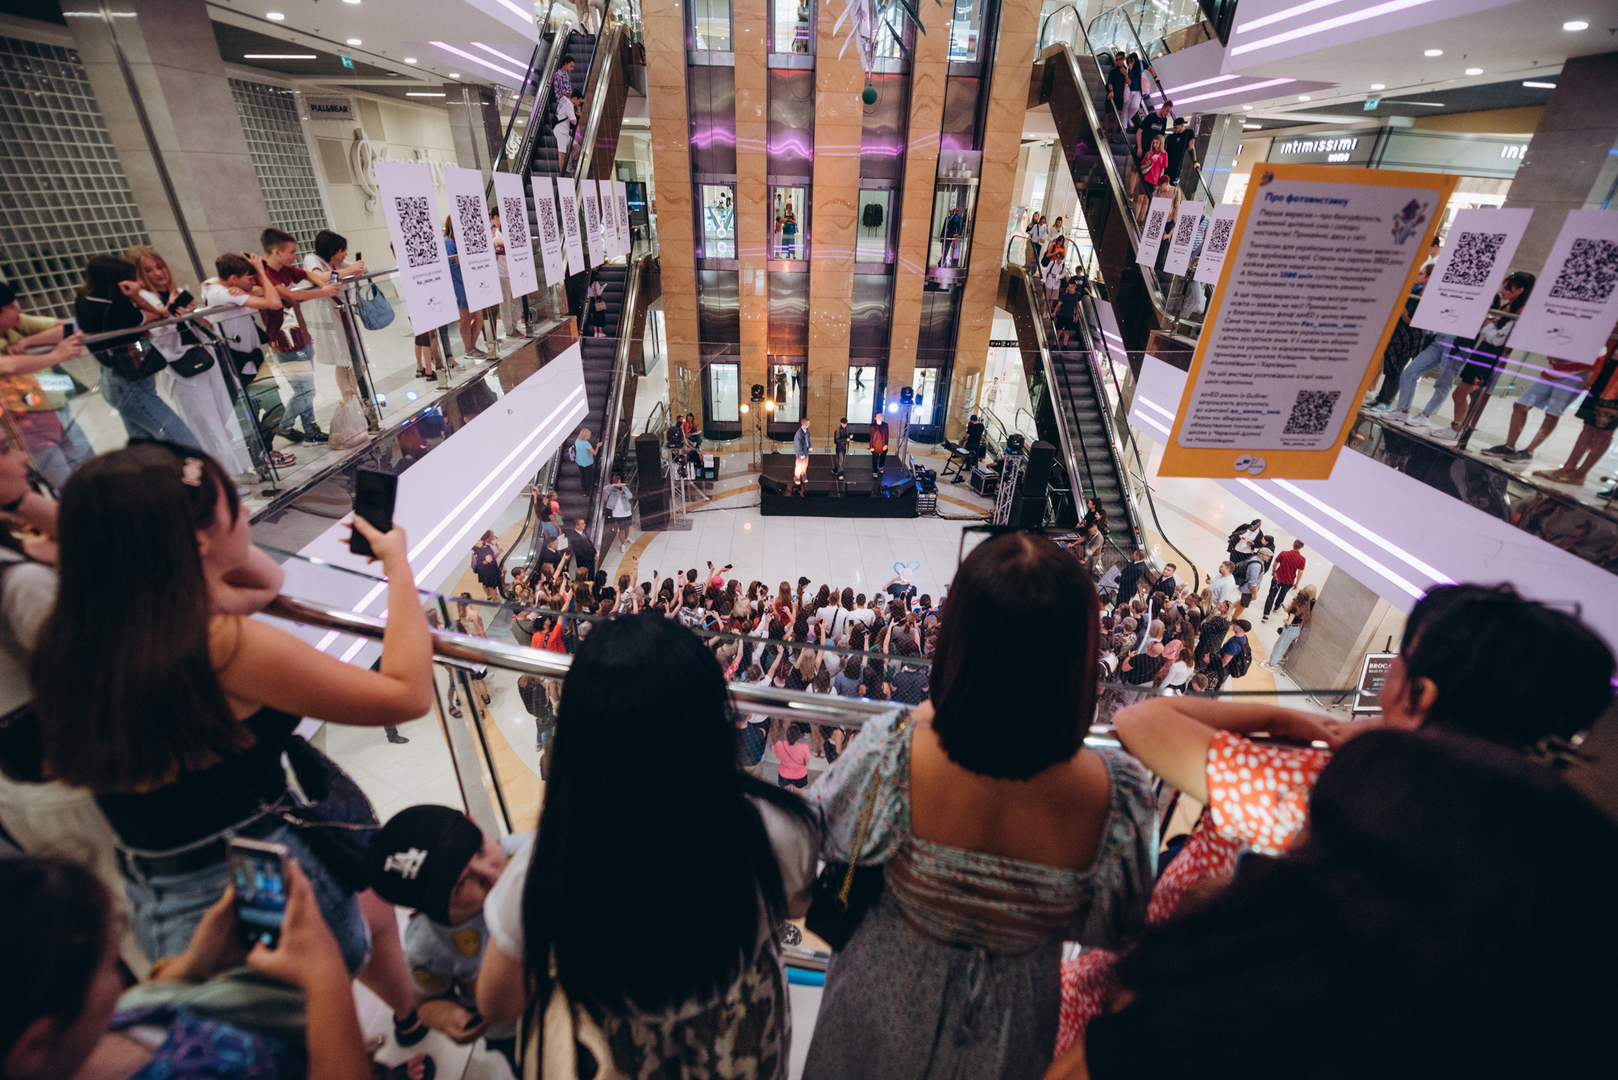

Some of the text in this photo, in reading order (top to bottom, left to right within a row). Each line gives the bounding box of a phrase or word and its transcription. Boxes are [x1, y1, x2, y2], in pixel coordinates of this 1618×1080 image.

[310, 104, 348, 113] PULL&BEAR
[1280, 138, 1357, 154] intimissimi
[1328, 153, 1350, 162] uomo
[1264, 191, 1349, 208] Про фотовиставку
[1260, 208, 1284, 217] Перше
[1293, 230, 1329, 239] Принаймні,
[1250, 241, 1281, 249] Тимчасом
[1233, 309, 1275, 318] благодійному
